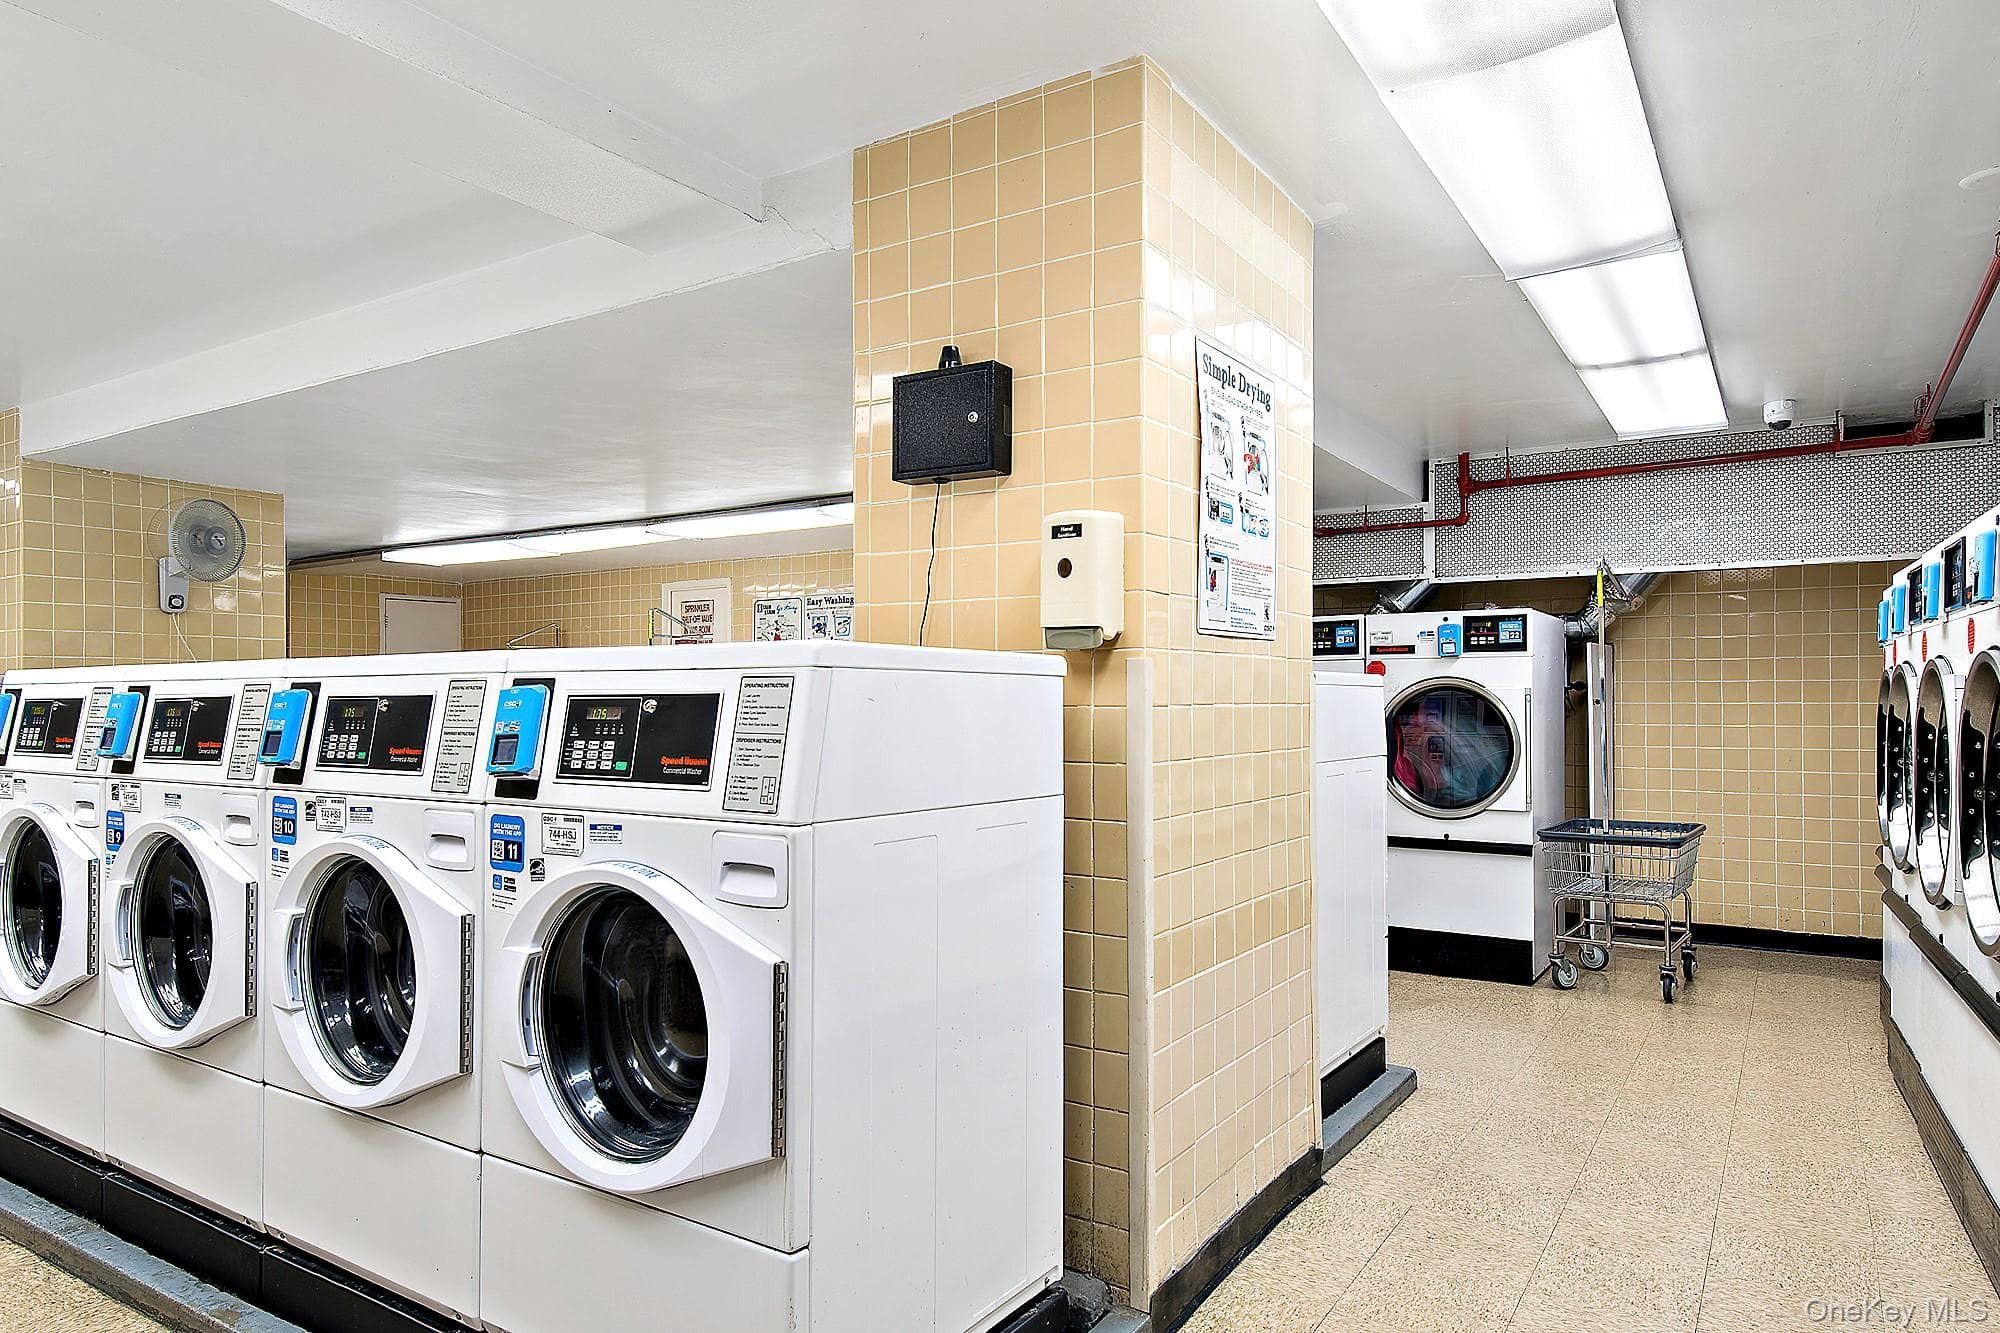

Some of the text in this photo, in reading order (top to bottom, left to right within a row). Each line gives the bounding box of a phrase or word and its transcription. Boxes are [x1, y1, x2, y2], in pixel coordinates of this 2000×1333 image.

[1202, 353, 1236, 389] Simple
[1238, 373, 1271, 412] Drying
[806, 595, 855, 607] Easy Washing
[684, 604, 710, 613] SPRINKLER
[389, 746, 405, 755] Speed
[660, 755, 708, 766] Speed Queen
[662, 766, 686, 774] Commercial
[283, 820, 293, 834] 10
[500, 823, 521, 831] LAUNDRY
[116, 831, 121, 843] 9
[548, 829, 577, 840] 744-HSJ
[507, 843, 518, 860] 11
